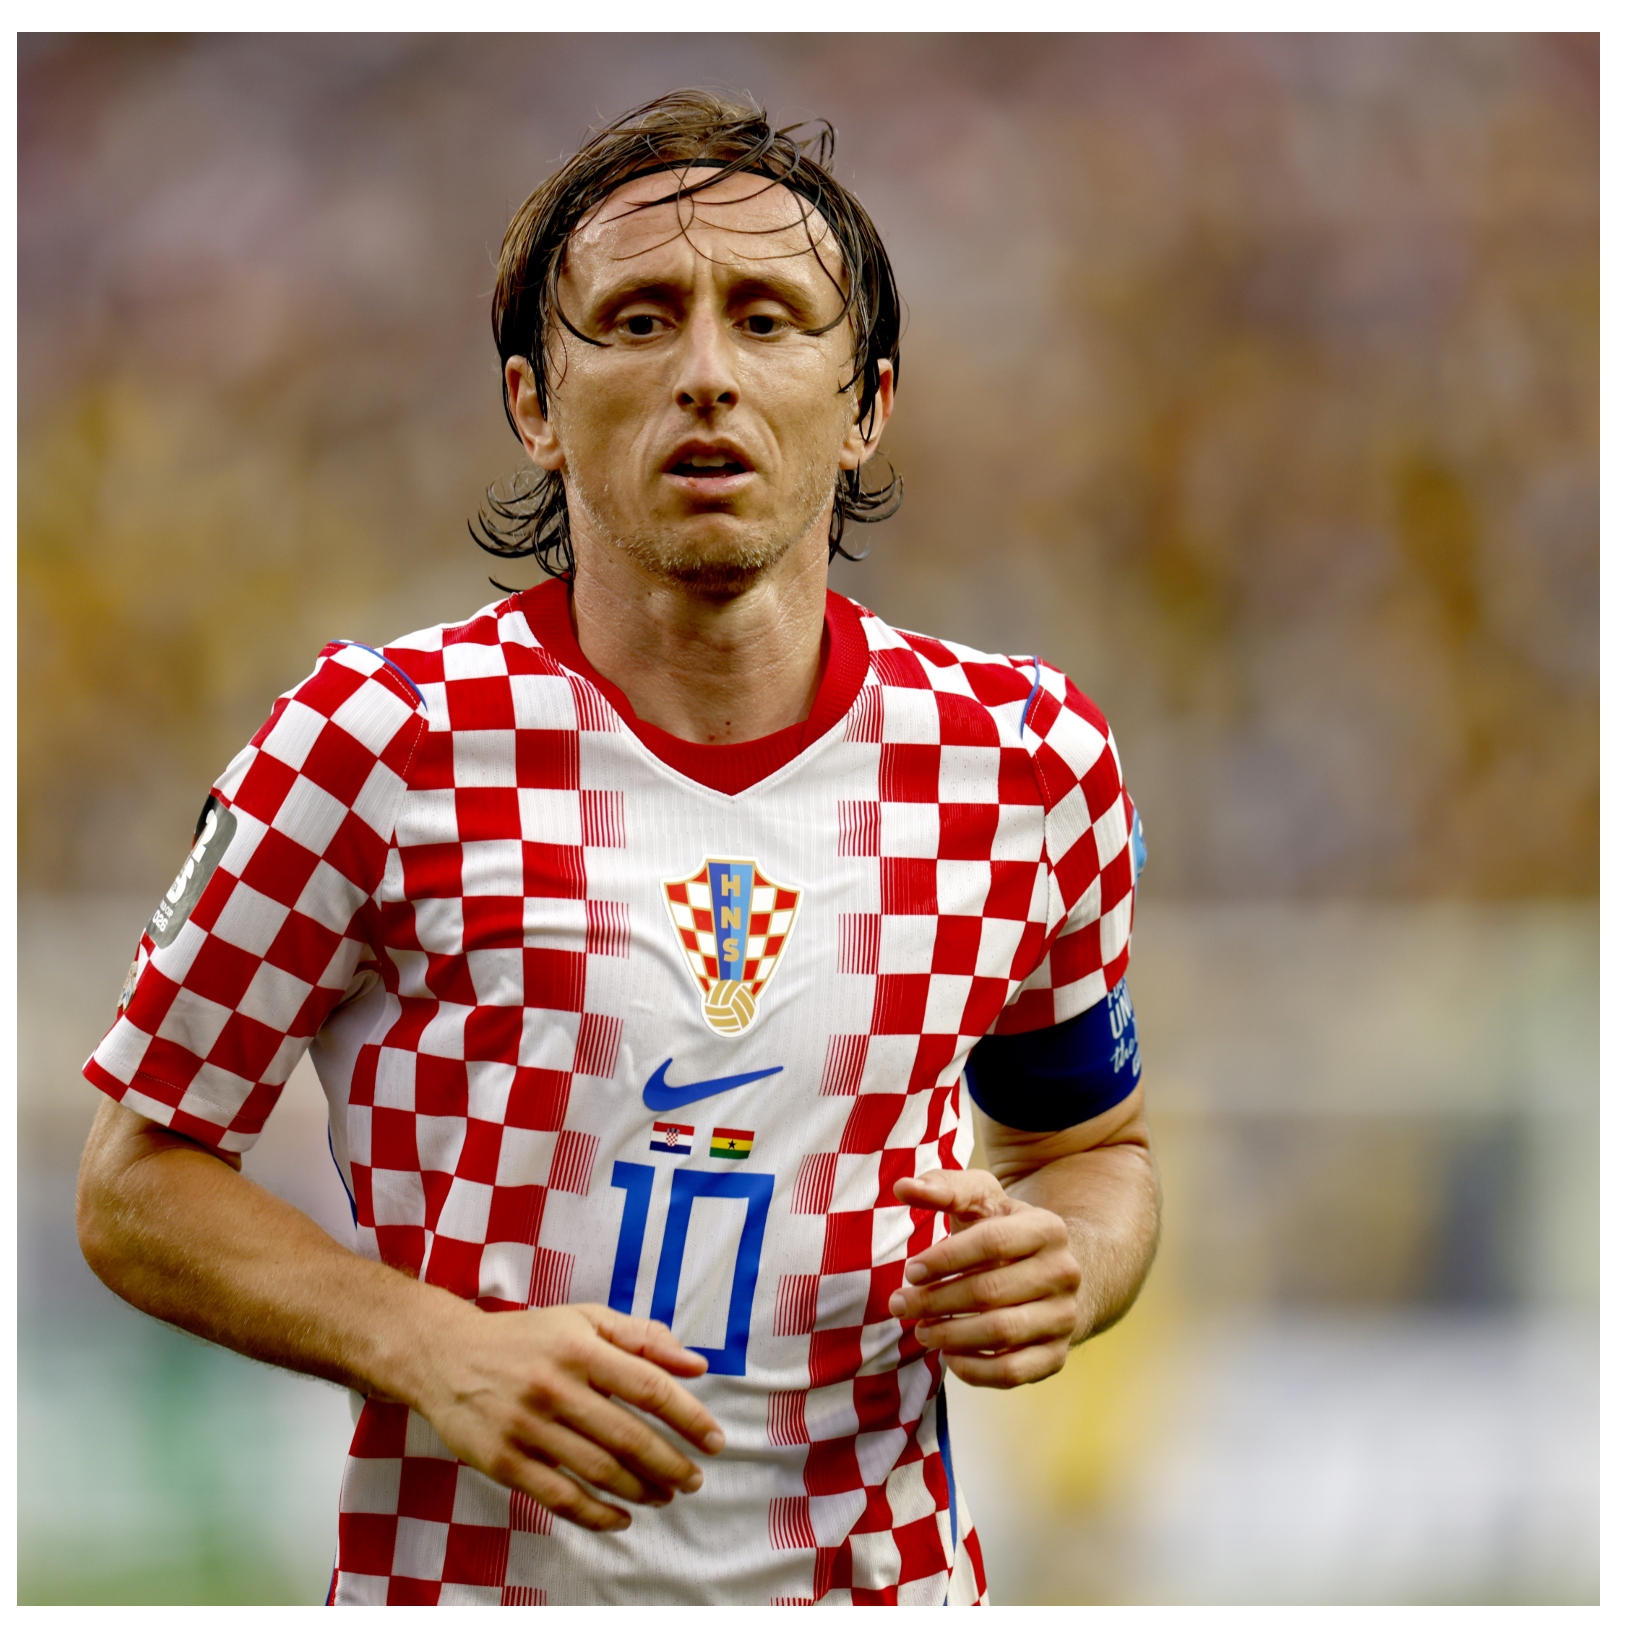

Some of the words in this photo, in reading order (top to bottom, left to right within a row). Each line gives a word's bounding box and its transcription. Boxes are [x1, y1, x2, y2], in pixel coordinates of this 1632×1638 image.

[152, 909, 168, 932] 026
[721, 873, 741, 962] HNS
[608, 1160, 775, 1376] 10
